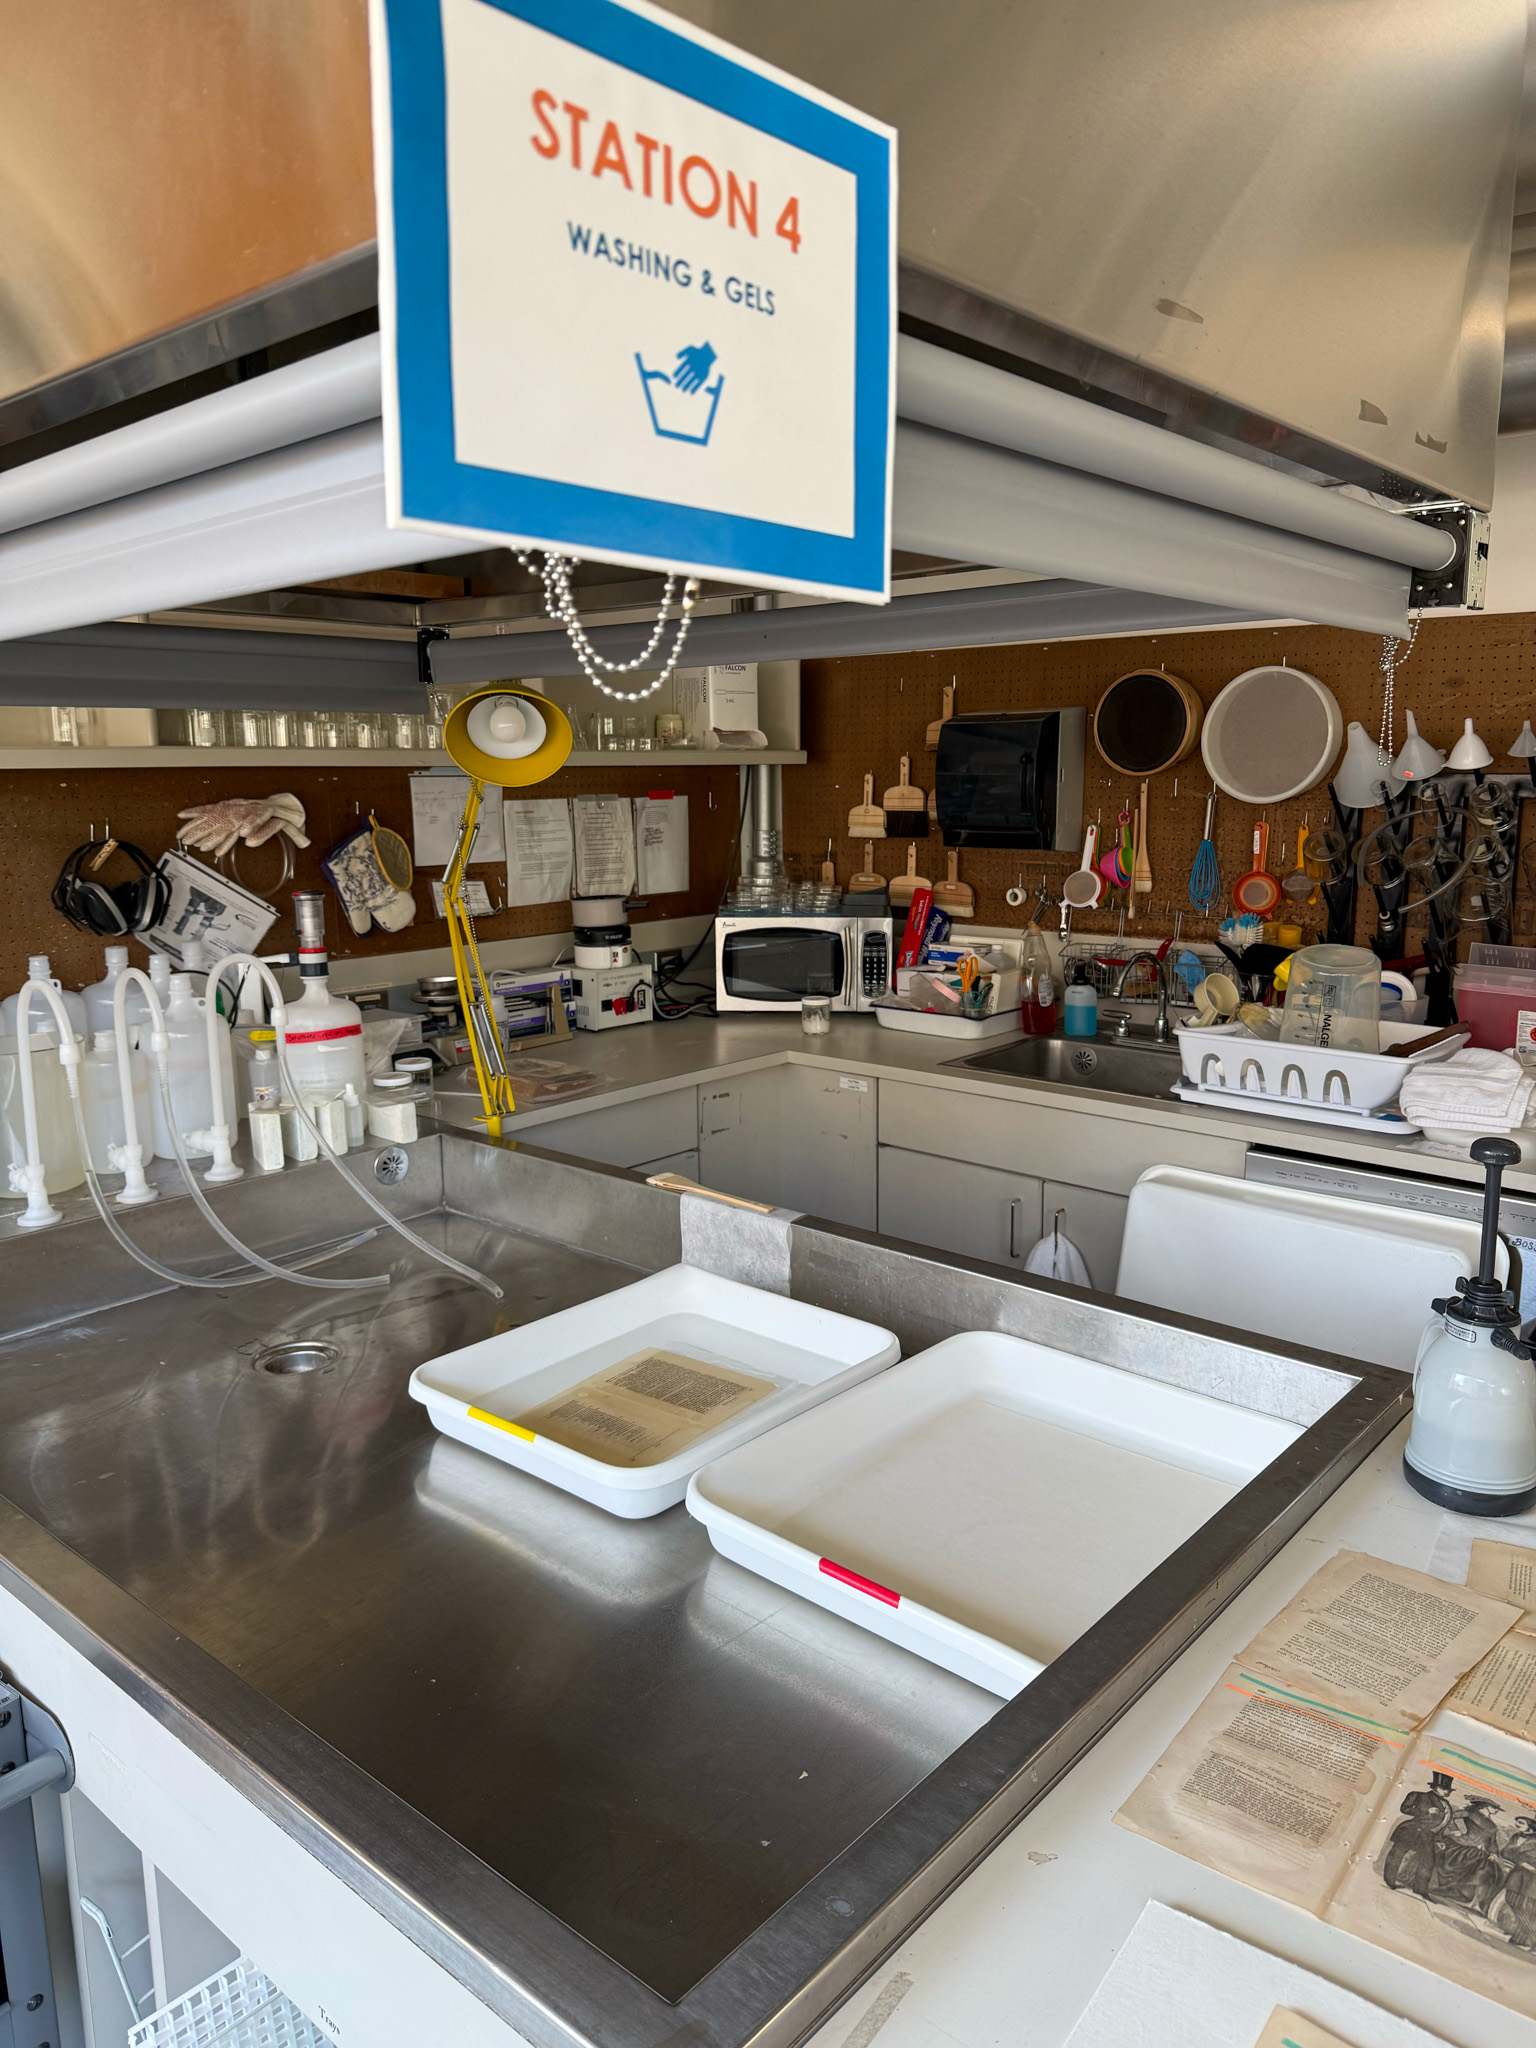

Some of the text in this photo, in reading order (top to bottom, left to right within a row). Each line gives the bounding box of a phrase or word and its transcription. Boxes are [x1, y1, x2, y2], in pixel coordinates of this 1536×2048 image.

[531, 88, 803, 255] STATION 4
[566, 220, 776, 317] WASHING & GELS
[924, 913, 943, 946] Reynolds
[1511, 1237, 1536, 1252] BOS
[318, 2005, 341, 2035] Trays
